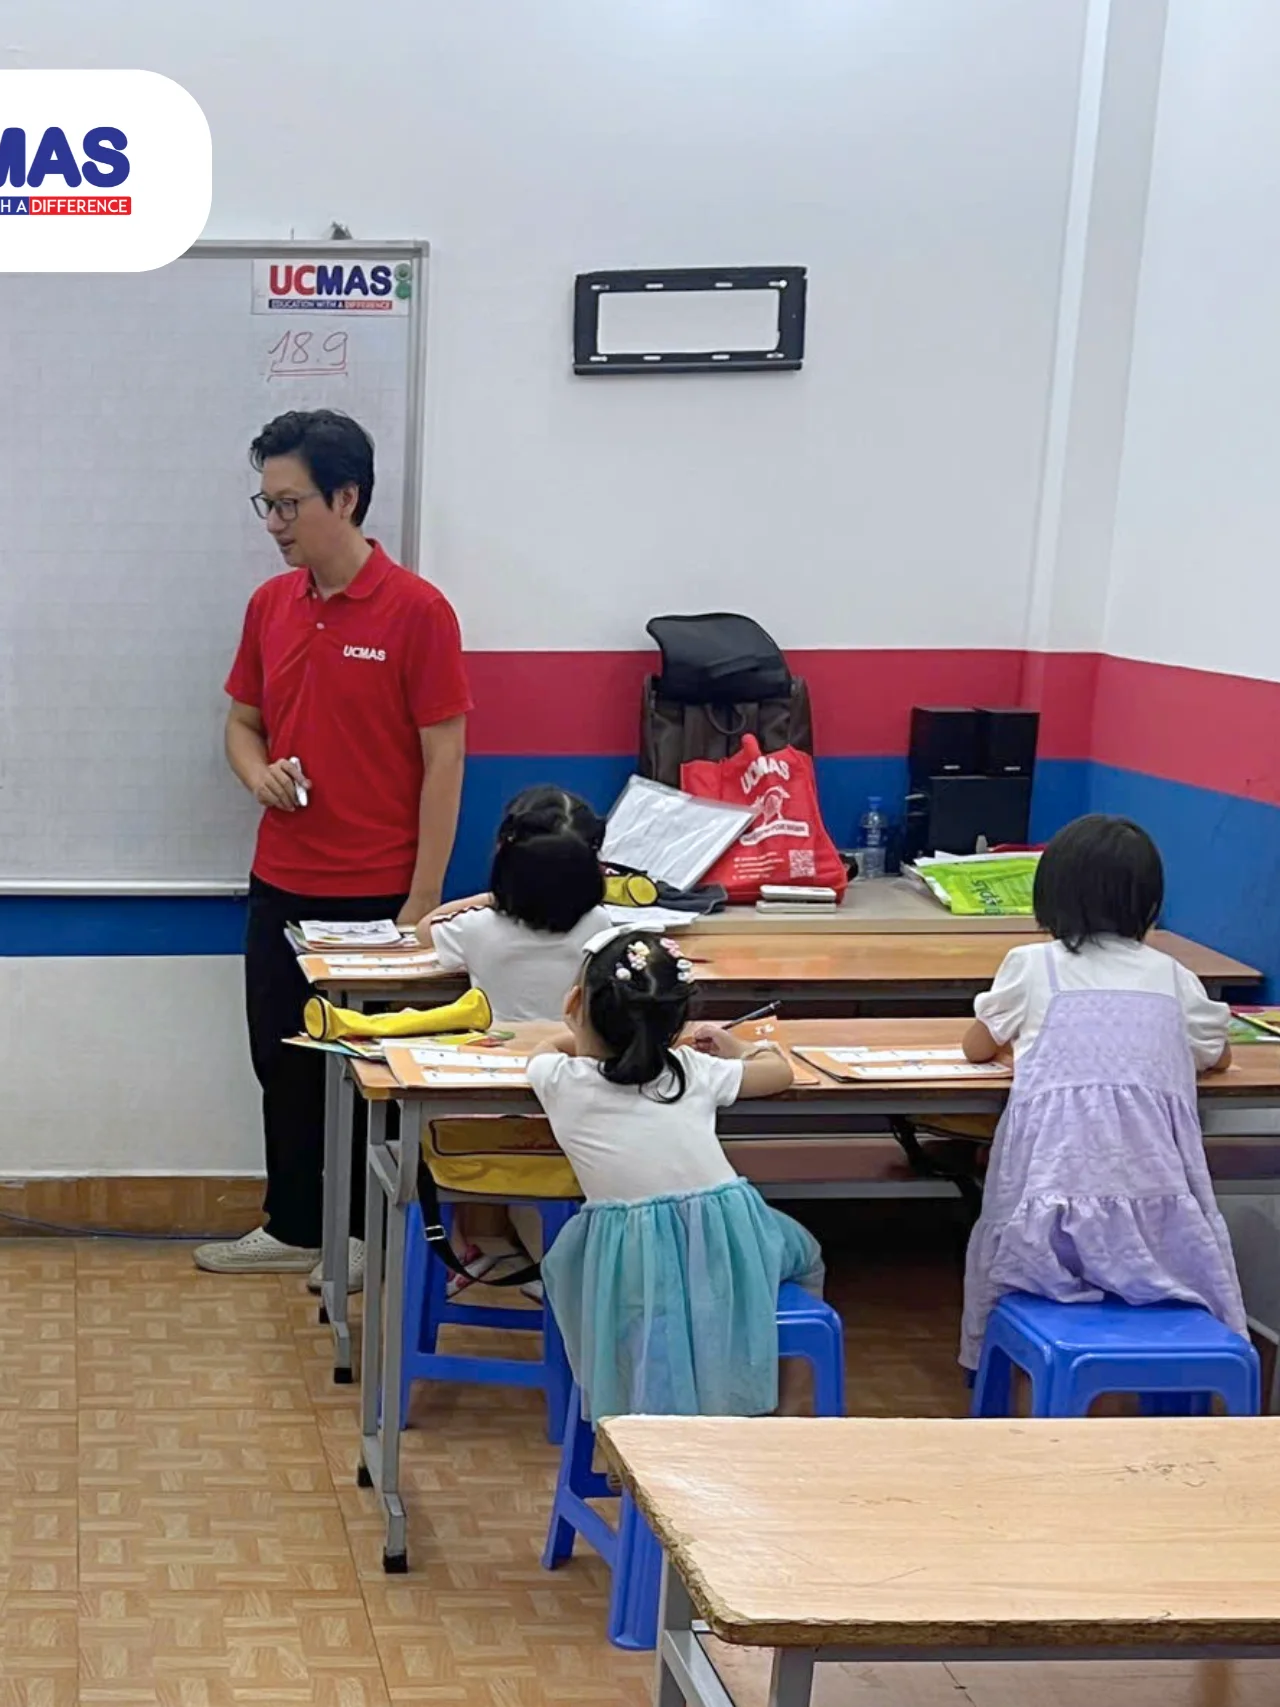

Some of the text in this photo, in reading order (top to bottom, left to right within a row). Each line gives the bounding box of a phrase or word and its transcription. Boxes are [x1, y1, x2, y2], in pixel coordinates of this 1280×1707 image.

[269, 265, 392, 296] UCMAS
[271, 300, 315, 309] EDUCATION
[343, 644, 386, 661] UCMAS
[740, 755, 790, 794] UCMAS
